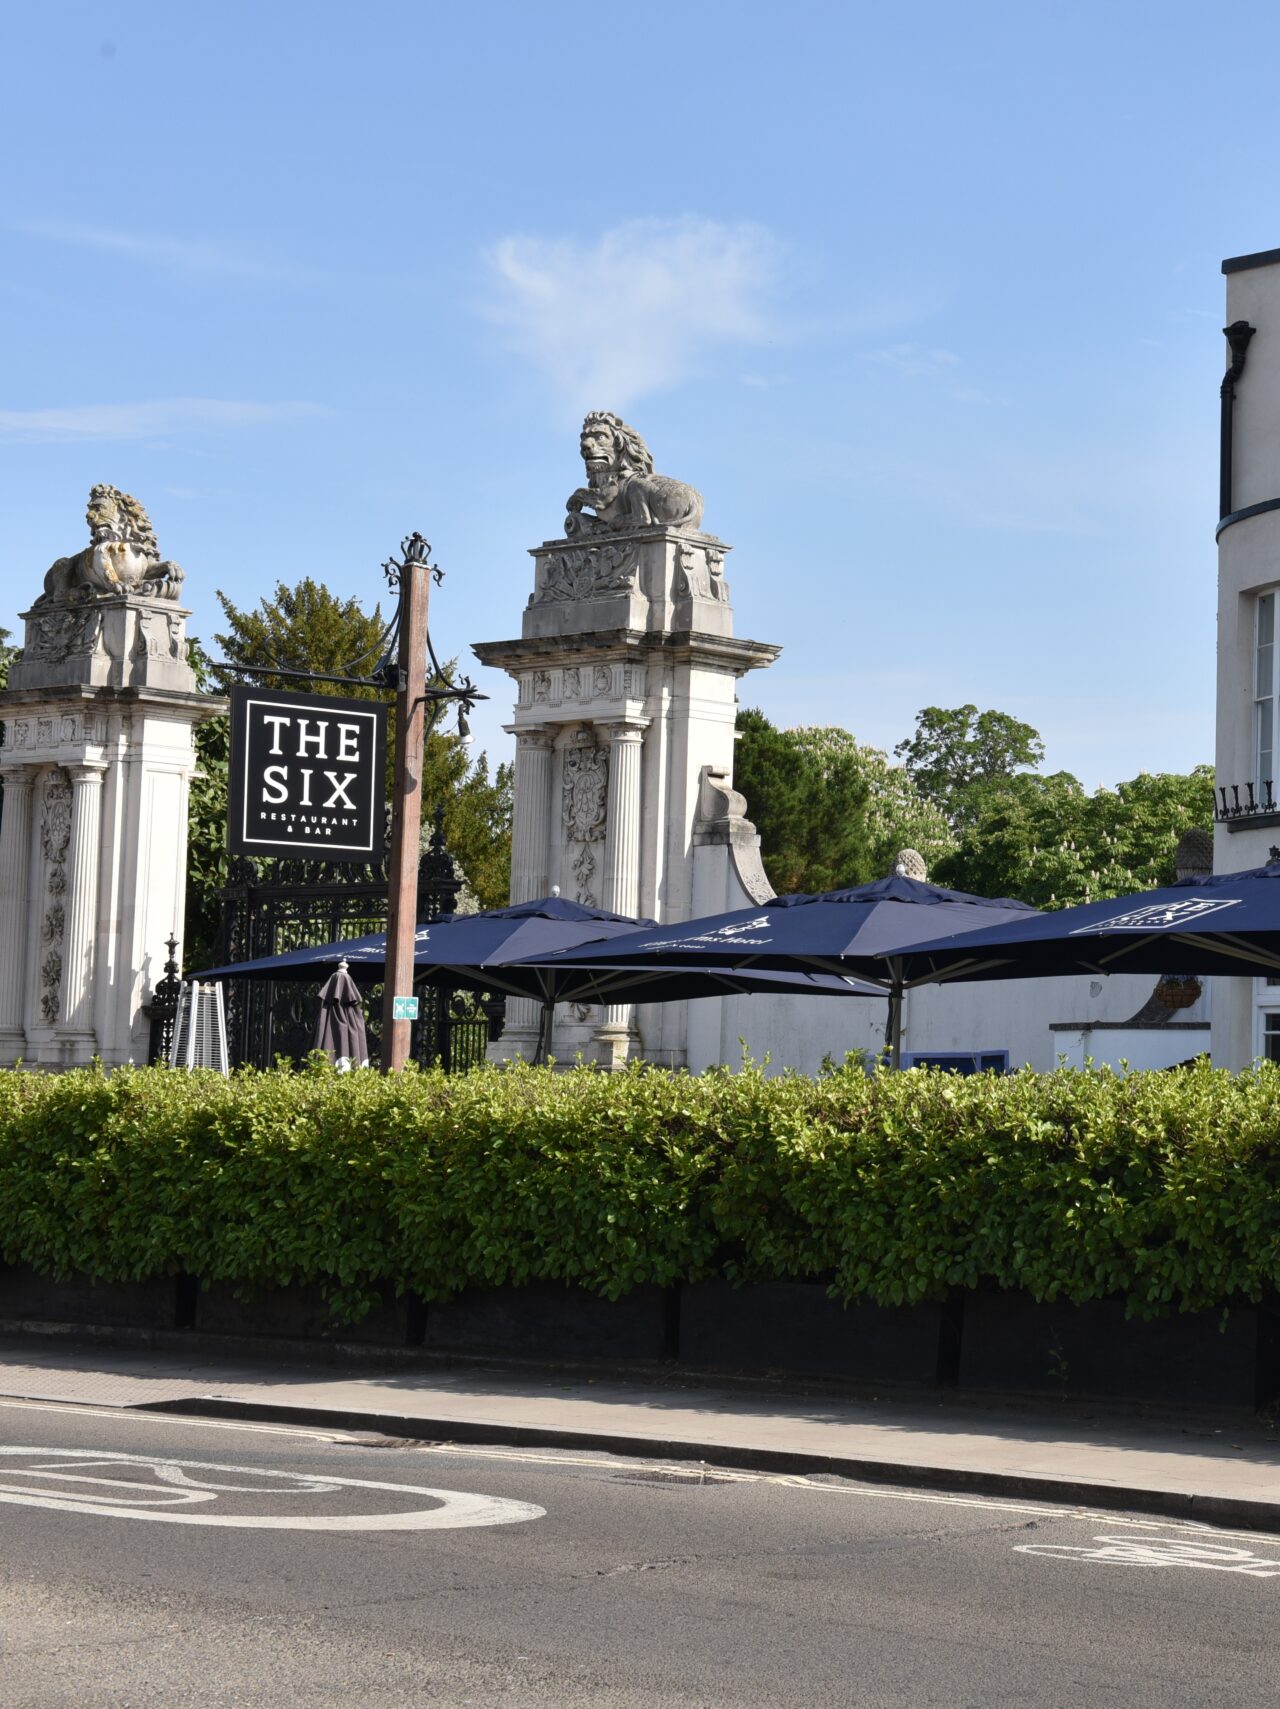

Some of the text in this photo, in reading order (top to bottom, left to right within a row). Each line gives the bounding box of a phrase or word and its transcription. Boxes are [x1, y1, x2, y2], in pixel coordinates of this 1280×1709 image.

[263, 715, 360, 763] THE
[262, 765, 358, 810] SIX
[260, 812, 358, 826] RESTAURANT
[287, 825, 332, 836] & BAR
